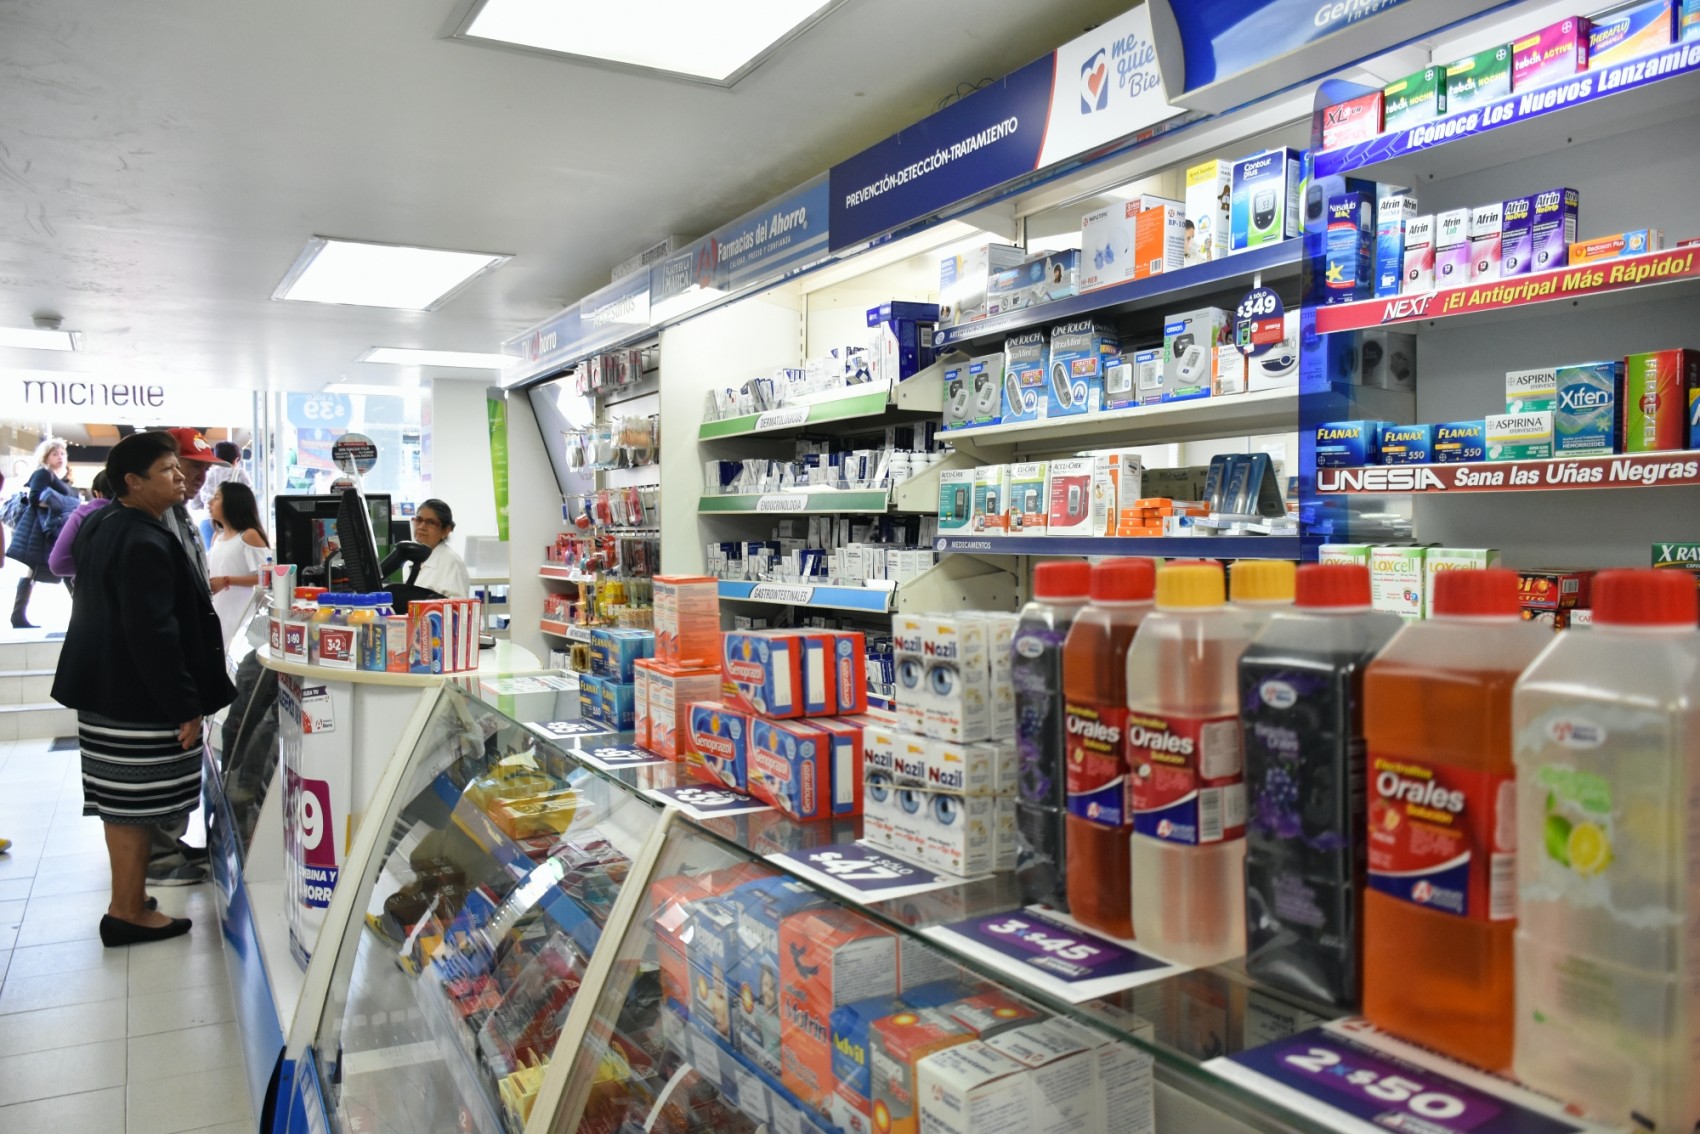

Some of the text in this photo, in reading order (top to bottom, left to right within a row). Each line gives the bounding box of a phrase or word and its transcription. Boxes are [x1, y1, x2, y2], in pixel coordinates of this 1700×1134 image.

[1111, 33, 1138, 60] me
[1515, 43, 1574, 70] tabcin ACTIVE
[1478, 72, 1507, 86] NOCHE
[1410, 92, 1434, 105] NOCHE
[1407, 115, 1477, 149] ¡Conoce
[1482, 101, 1514, 127] Los
[1519, 78, 1592, 116] Nuevos
[1244, 158, 1271, 171] Contour
[1243, 169, 1258, 180] plus
[1380, 199, 1400, 211] Afrin
[1505, 200, 1529, 215] Afrin
[1535, 192, 1560, 207] Afrin
[1443, 217, 1461, 228] Afrin
[1476, 212, 1498, 225] Afrin
[717, 207, 806, 263] Farmacias del Ahorro
[1409, 223, 1429, 235] Afrin
[1587, 240, 1625, 252] Redoxon Plus
[1443, 290, 1467, 313] ¡El
[1468, 277, 1557, 306] Antigripal
[1562, 270, 1604, 292] Más
[1609, 253, 1693, 284] Rápido!
[1237, 295, 1276, 319] $349
[1166, 324, 1183, 333] omron
[1515, 373, 1555, 385] ASPIRIN
[23, 380, 164, 407] michelle
[1560, 387, 1608, 409] Xifen
[1643, 358, 1657, 447] FERREXEL
[1495, 416, 1542, 430] ASPIRINA
[1509, 427, 1544, 435] EFERVESCENTE
[1317, 428, 1361, 440] FLANAX
[1384, 431, 1423, 442] FLANAX
[1438, 428, 1480, 439] FLANAX
[1463, 448, 1482, 457] 550
[1562, 441, 1605, 449] HEMORROIDES
[1408, 451, 1425, 460] 550
[1318, 460, 1698, 491] UNESIA Sana las Uñas Negras
[951, 541, 992, 549] MEDICAMENTOS
[1659, 545, 1674, 562] X
[754, 587, 808, 603] GASTROINTESTINALES
[327, 639, 342, 651] 3x2
[374, 627, 383, 666] FLANAX
[895, 636, 921, 653] Nazil
[924, 641, 957, 658] Nazil
[731, 663, 763, 680] Genoprazol
[580, 681, 599, 694] FLANAX
[841, 661, 850, 708] Genoprazol
[1067, 715, 1120, 743] Orales
[695, 734, 732, 755] Genoprazol
[1130, 726, 1194, 755] Orales
[755, 750, 789, 776] Genoprazol
[865, 748, 893, 768] Nazil
[895, 758, 925, 779] Nazil
[929, 767, 963, 788] Nazil
[802, 763, 811, 812] Genoprazol
[1376, 771, 1465, 812] Orales
[809, 851, 900, 880] $47
[875, 857, 914, 875] SÓLO
[330, 871, 337, 882] Y
[785, 998, 828, 1044] Motrin
[834, 1032, 865, 1065] Advil
